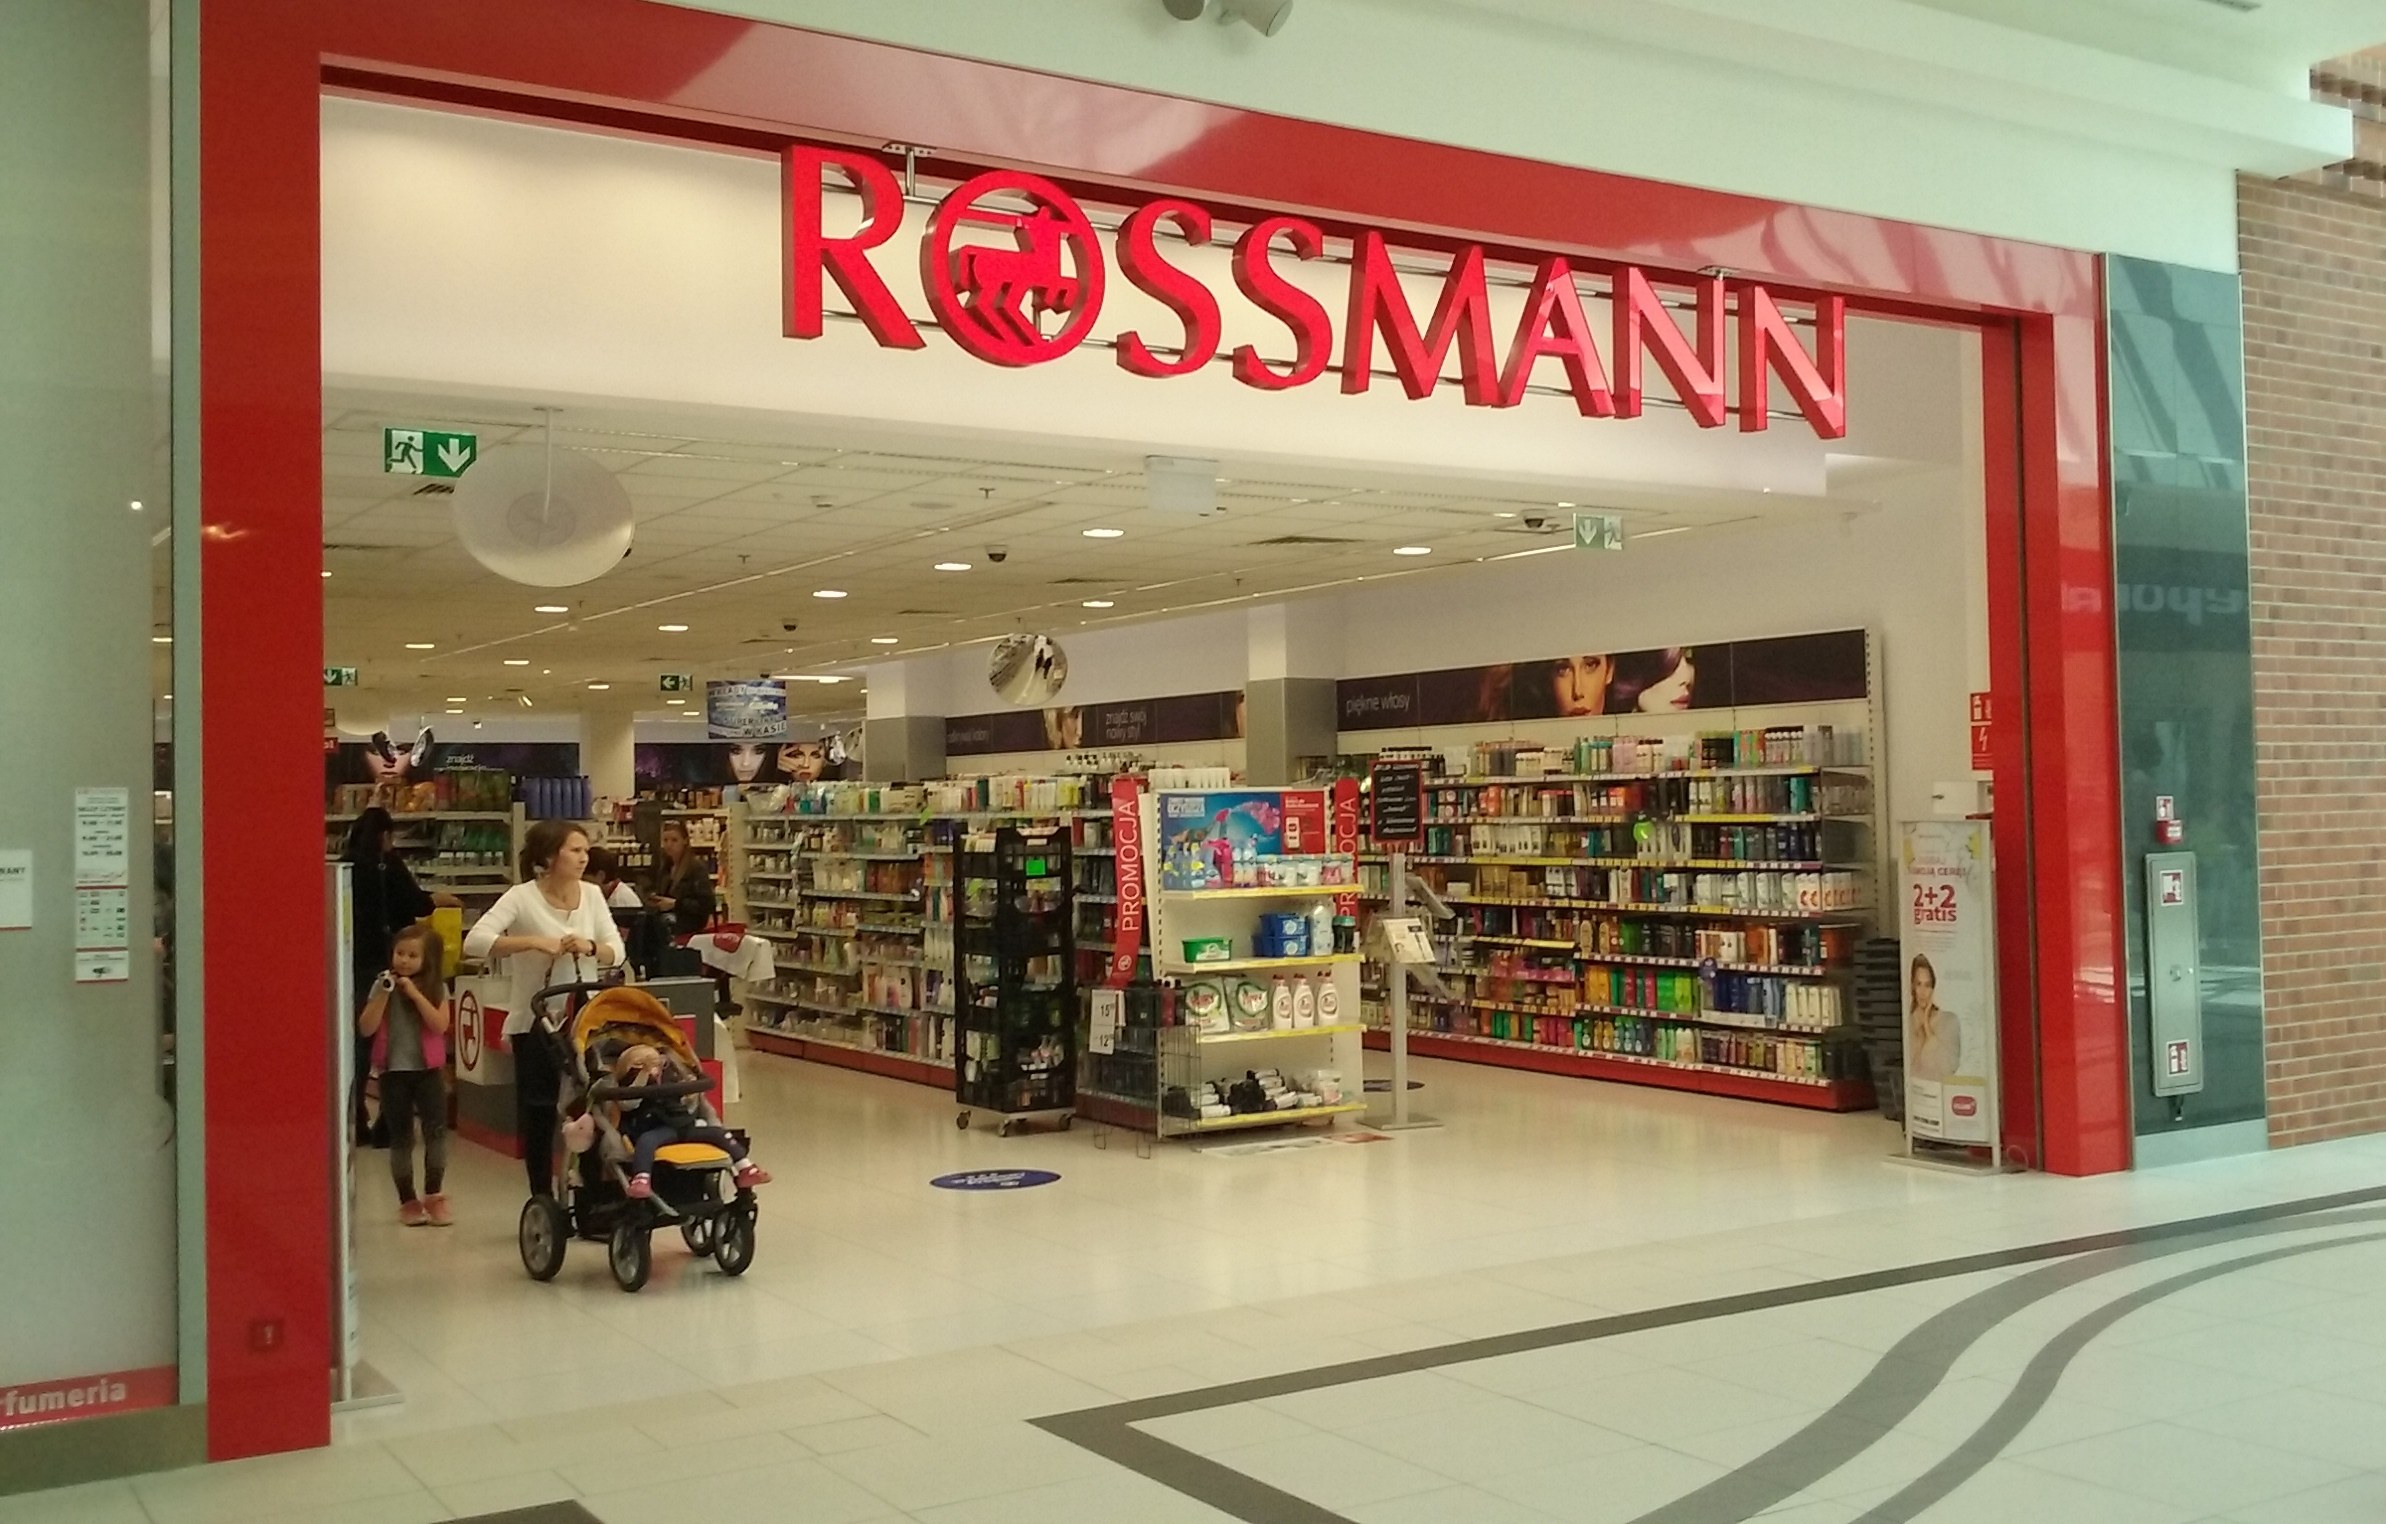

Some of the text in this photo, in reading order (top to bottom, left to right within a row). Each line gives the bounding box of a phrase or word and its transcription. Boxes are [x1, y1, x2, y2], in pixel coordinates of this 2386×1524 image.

[782, 144, 1847, 440] ROSSMANN
[1118, 800, 1140, 932] PROMOCJA
[1340, 797, 1356, 917] PROCJA
[1913, 883, 1957, 909] 2+2
[1914, 906, 1957, 925] gratis
[0, 1378, 127, 1416] fumeria
